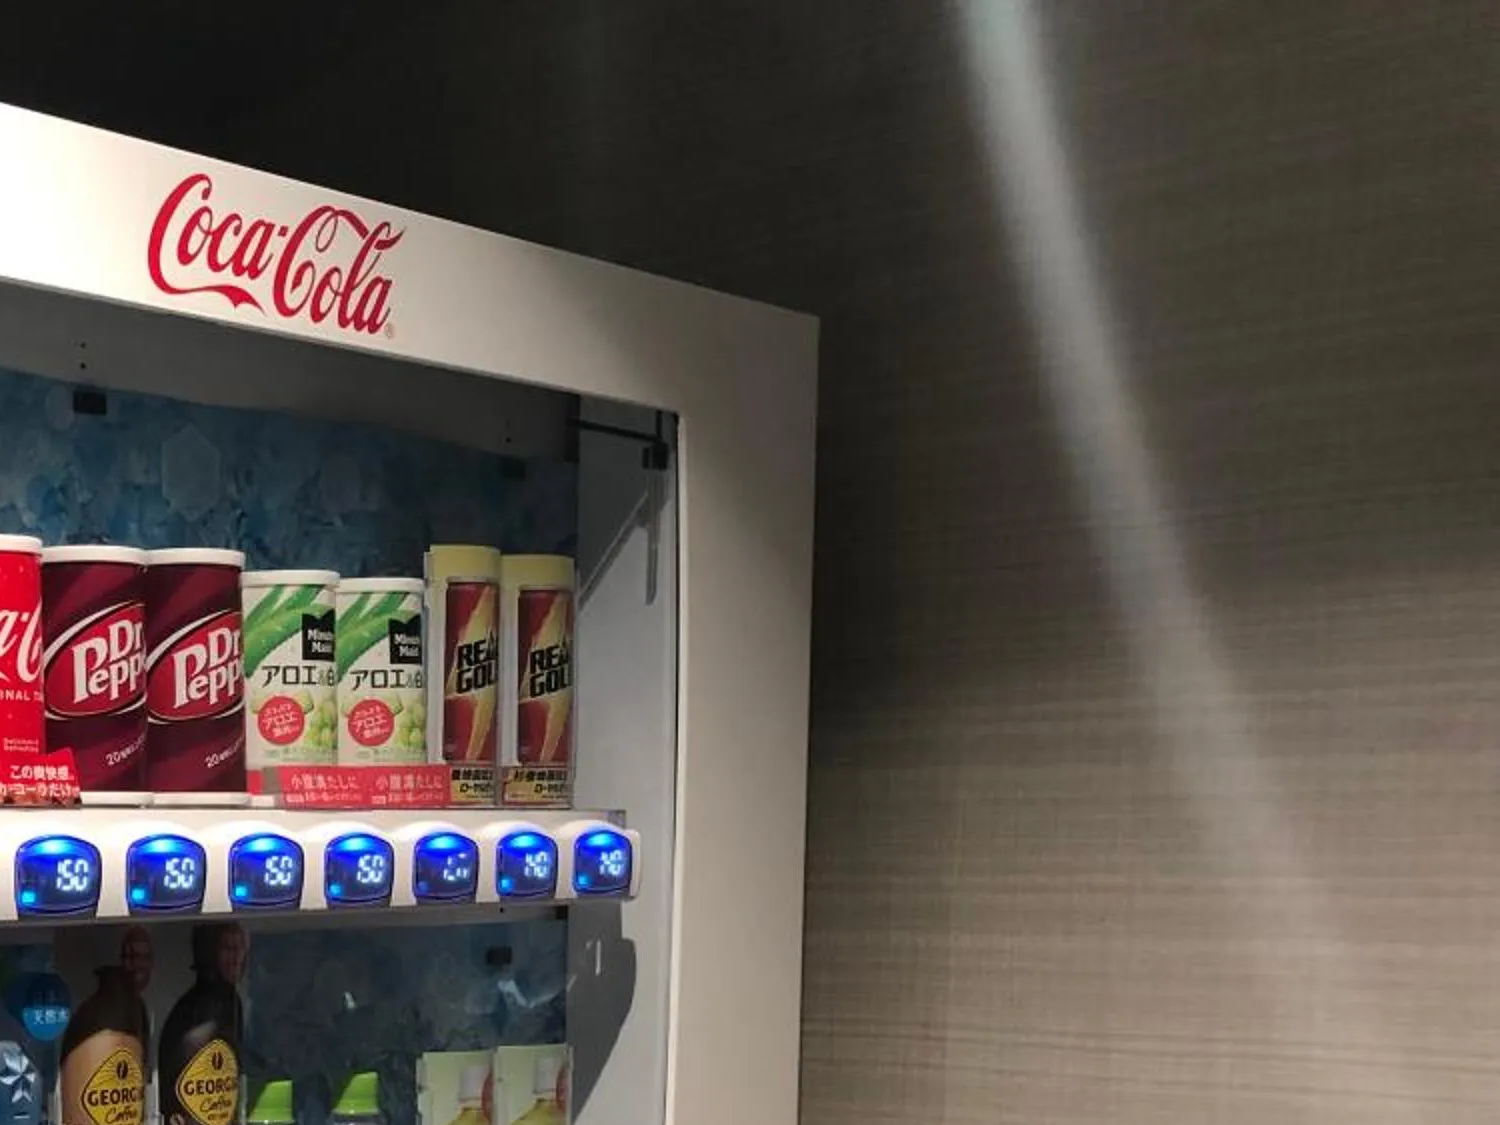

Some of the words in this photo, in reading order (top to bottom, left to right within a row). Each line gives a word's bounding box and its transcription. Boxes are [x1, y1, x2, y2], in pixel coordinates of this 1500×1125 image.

[148, 173, 404, 334] Coca-Cola
[56, 857, 89, 892] 150
[164, 857, 195, 889] 150
[264, 855, 293, 886] 150
[357, 854, 385, 884] 150
